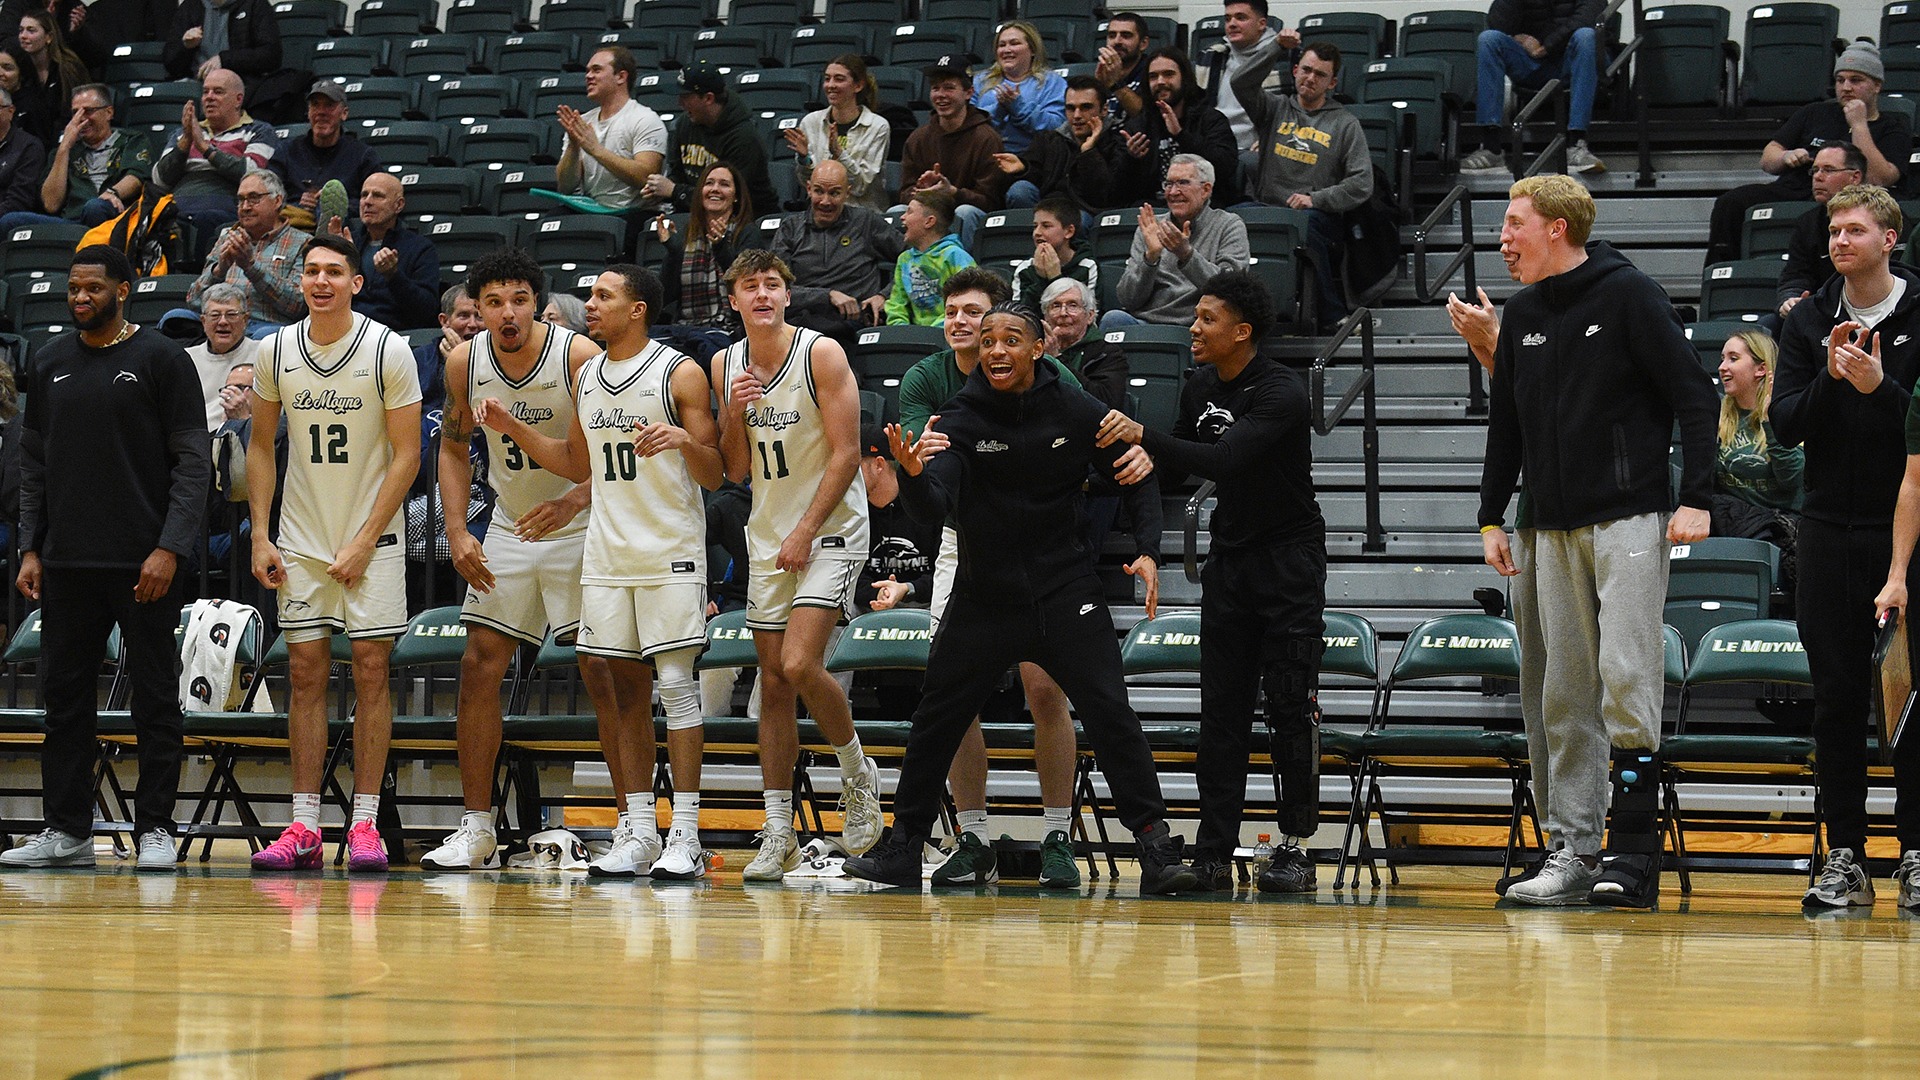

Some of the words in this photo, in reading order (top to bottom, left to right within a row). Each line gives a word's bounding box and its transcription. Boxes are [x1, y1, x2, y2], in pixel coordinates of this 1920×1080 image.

[509, 173, 520, 181] 22
[1757, 210, 1768, 218] 14
[991, 217, 1002, 225] 17
[1106, 217, 1116, 225] 16
[437, 224, 448, 232] 22
[1718, 269, 1728, 277] 14
[143, 283, 153, 291] 24
[583, 277, 594, 285] 20
[36, 284, 47, 292] 25
[865, 334, 876, 342] 17
[1110, 333, 1121, 342] 15
[292, 389, 313, 410] Le
[313, 389, 363, 414] Moyne
[588, 408, 606, 429] Le
[757, 406, 801, 431] Moyne
[308, 423, 350, 464] 12
[602, 442, 637, 481] 10
[757, 440, 790, 480] 11
[1674, 547, 1684, 557] 11
[414, 624, 439, 637] LE
[712, 627, 737, 640] LE
[852, 627, 878, 640] LE
[878, 627, 931, 641] MOYN
[1136, 632, 1162, 645] LE
[1162, 633, 1200, 646] MOY
[1322, 635, 1359, 648] YNE
[1420, 635, 1447, 648] LE
[1447, 635, 1513, 649] MOYNE
[1711, 639, 1739, 652] LE
[1739, 639, 1805, 653] MOYNE
